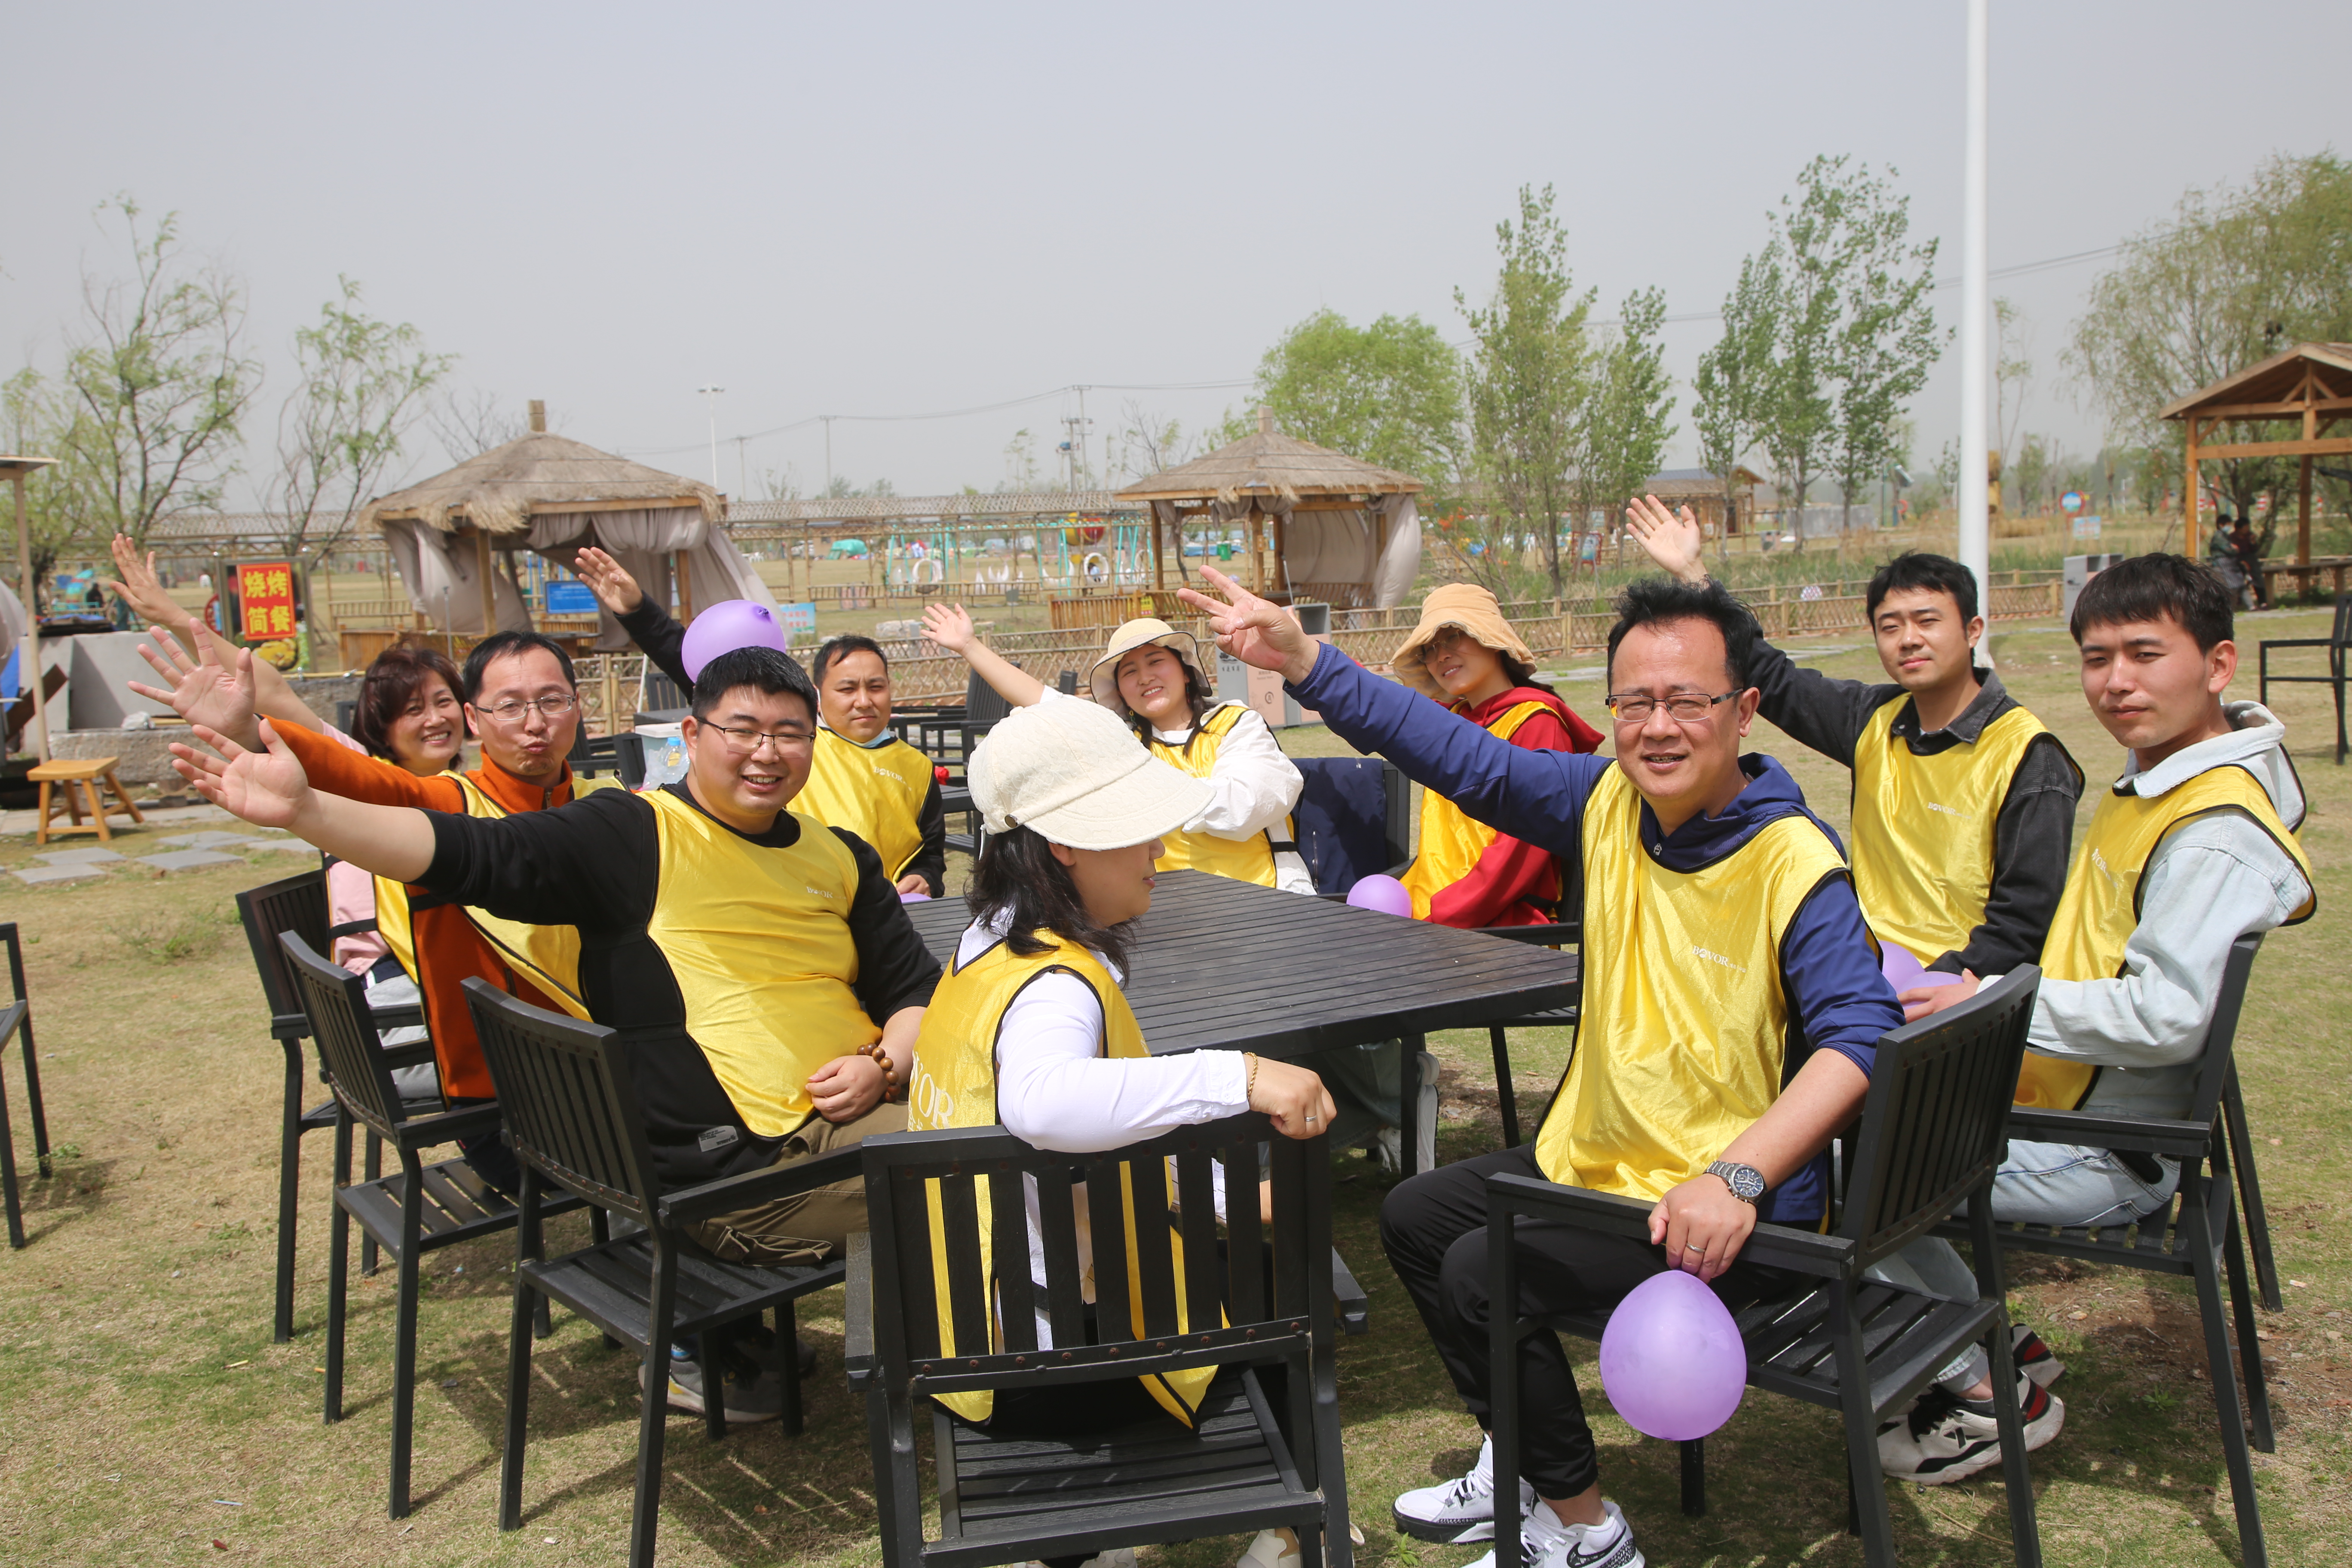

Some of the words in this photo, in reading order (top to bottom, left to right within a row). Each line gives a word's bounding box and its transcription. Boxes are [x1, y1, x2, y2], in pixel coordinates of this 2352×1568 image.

[244, 570, 288, 598] 烧烤
[247, 605, 291, 634] 简餐
[1693, 945, 1728, 967] BOVOR
[910, 1050, 954, 1130] VOR
